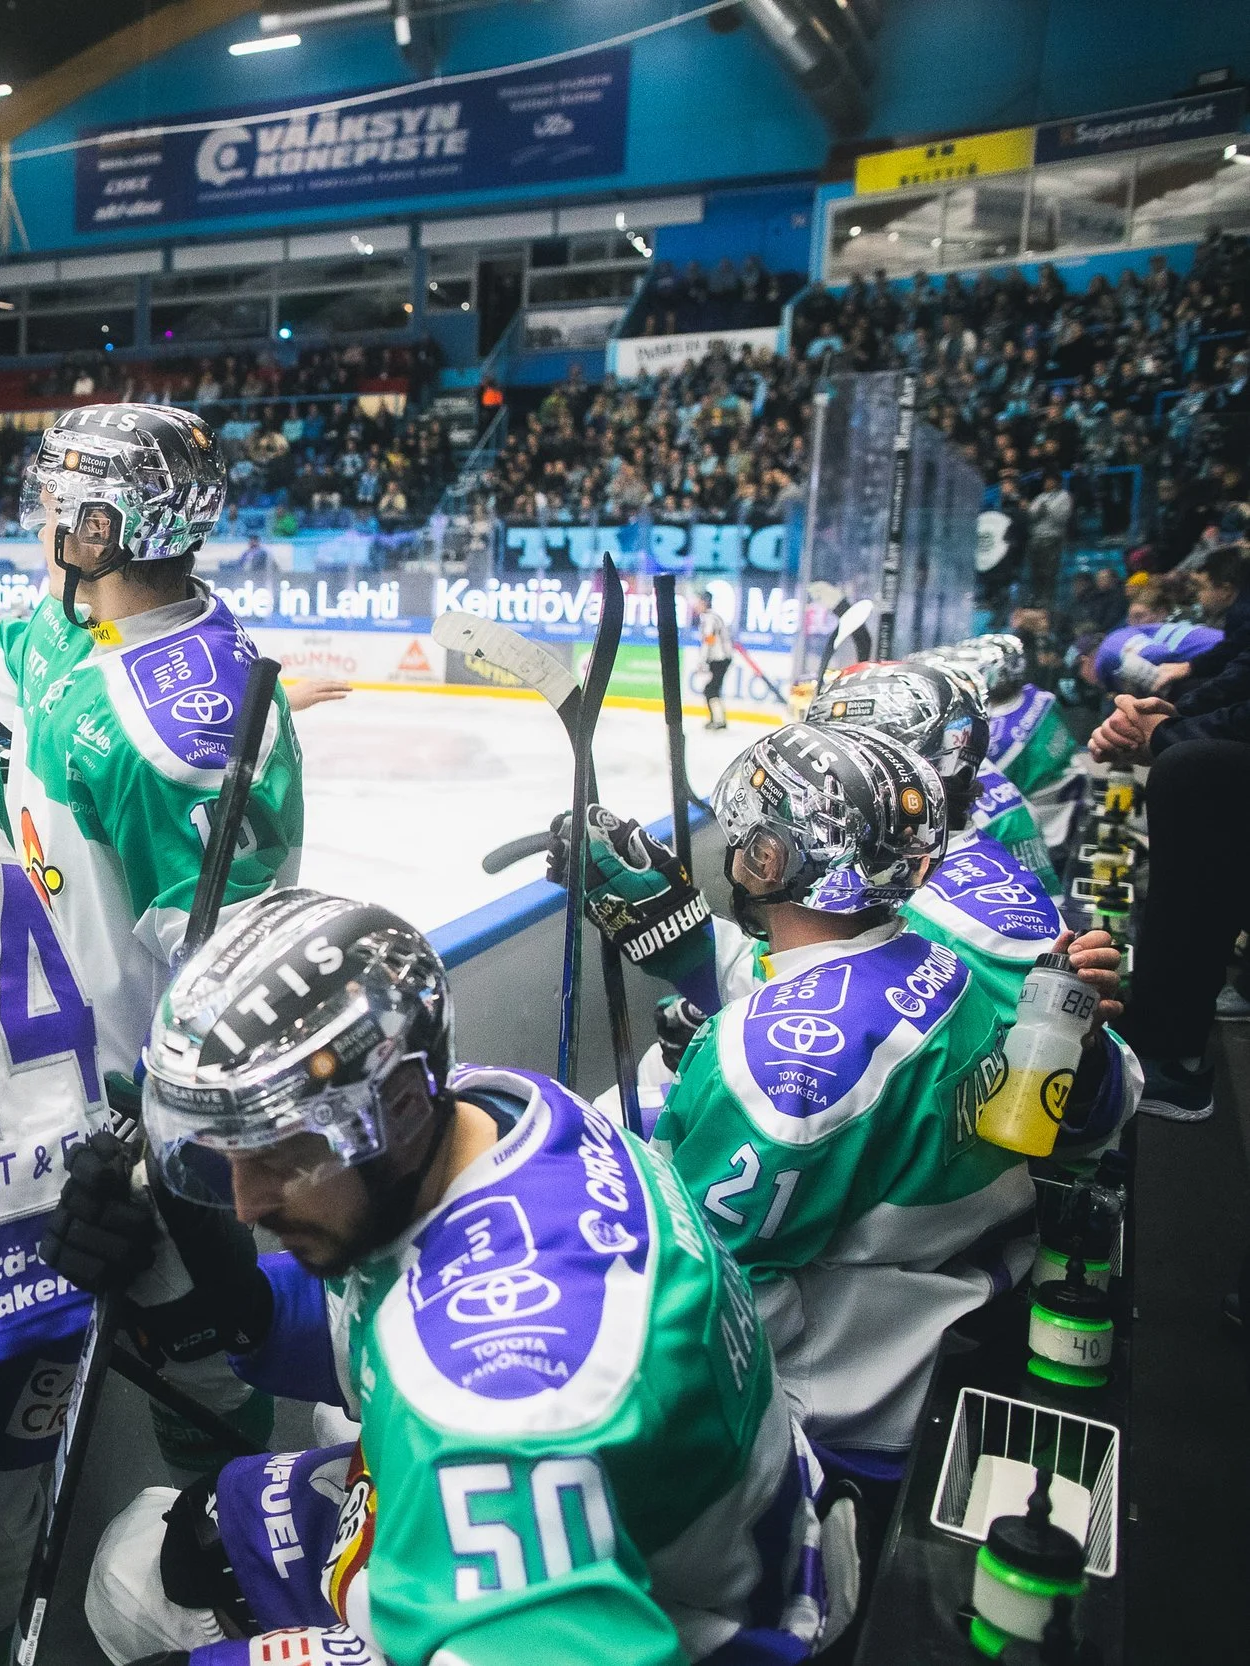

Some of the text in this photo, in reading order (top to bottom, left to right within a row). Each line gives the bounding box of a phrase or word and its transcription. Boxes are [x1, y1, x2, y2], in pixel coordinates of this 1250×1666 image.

[1075, 104, 1215, 143] Supermarket
[253, 128, 470, 178] KONEPISTE
[79, 462, 104, 476] keskus
[80, 454, 107, 467] Bitcoin
[280, 579, 310, 618] in
[316, 579, 400, 620] Lahti
[166, 645, 192, 681] inno
[152, 665, 178, 694] link
[192, 738, 227, 752] TOYOTA
[763, 776, 785, 800] Bitcoin
[954, 857, 988, 878] inno
[866, 888, 908, 898] PAIKKA
[1003, 913, 1044, 924] TOYOTA
[772, 981, 797, 1008] link
[800, 967, 827, 1000] inno
[778, 1070, 818, 1089] TOYOTA
[767, 1084, 828, 1106] KAIVOKSELA
[33, 1145, 52, 1180] &
[703, 1142, 801, 1240] 21
[472, 1336, 548, 1361] TOYOTA
[437, 1453, 616, 1603] 50
